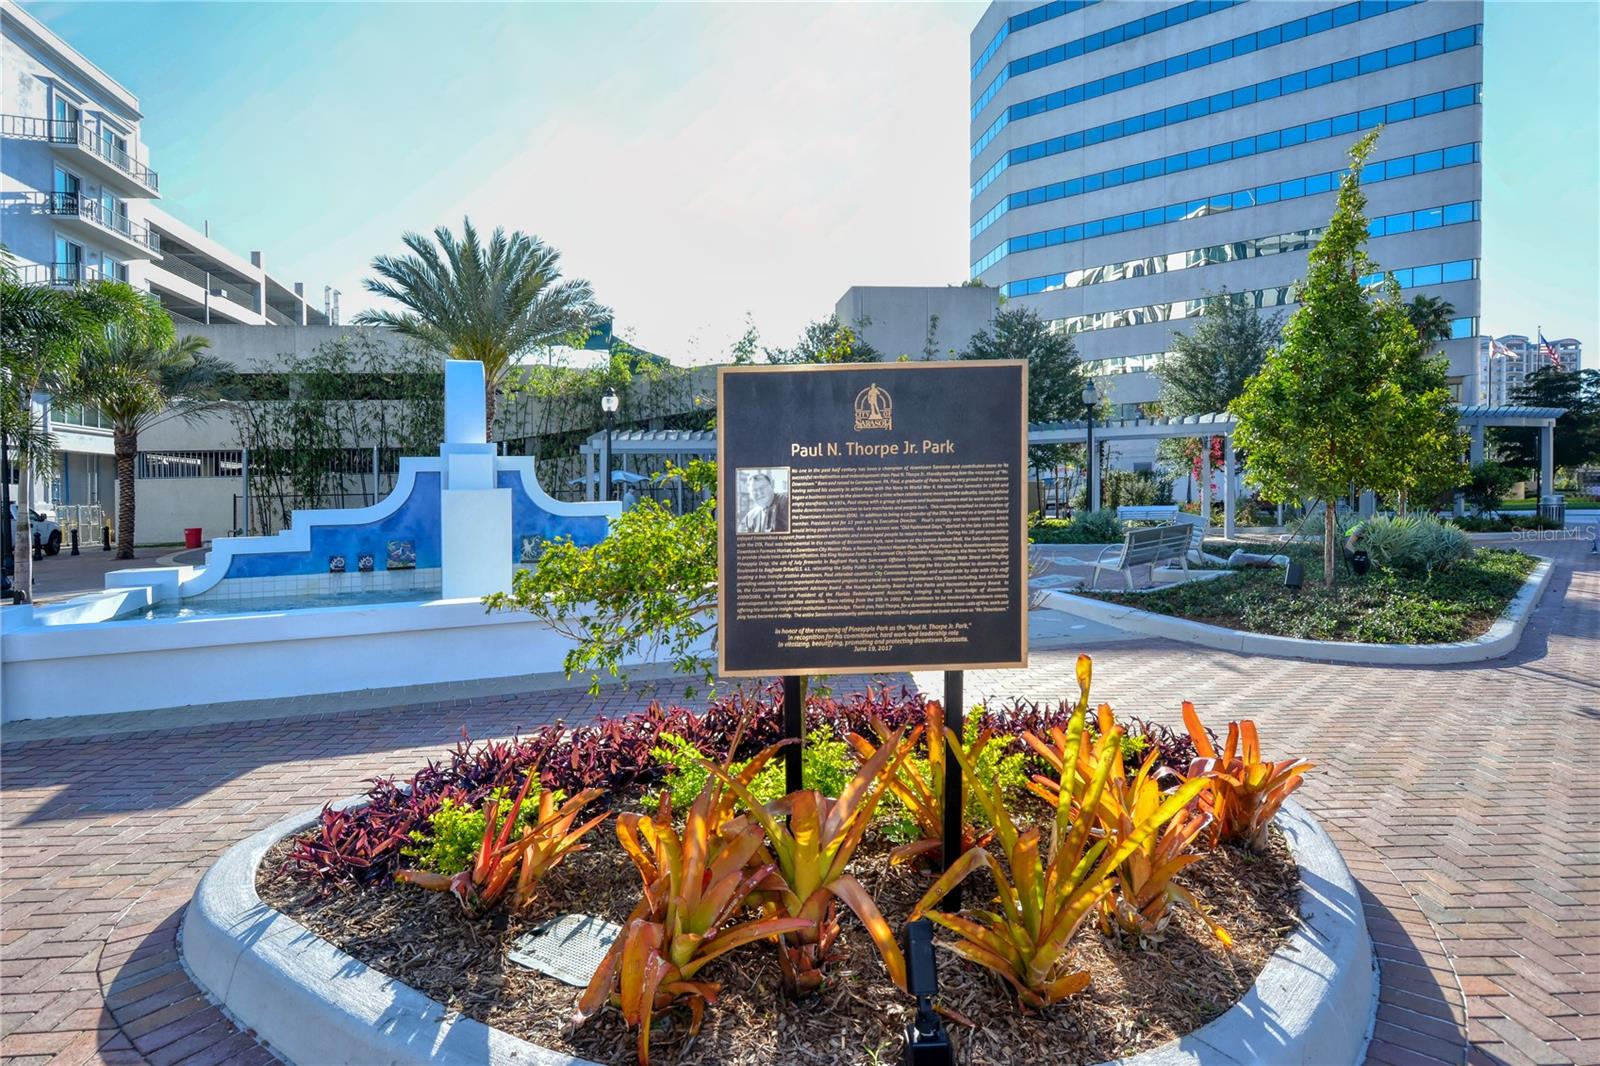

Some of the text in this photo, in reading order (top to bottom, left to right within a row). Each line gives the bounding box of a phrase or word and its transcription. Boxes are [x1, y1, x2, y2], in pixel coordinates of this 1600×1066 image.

[791, 439, 955, 458] Paul N. Thorpe Jr. Park
